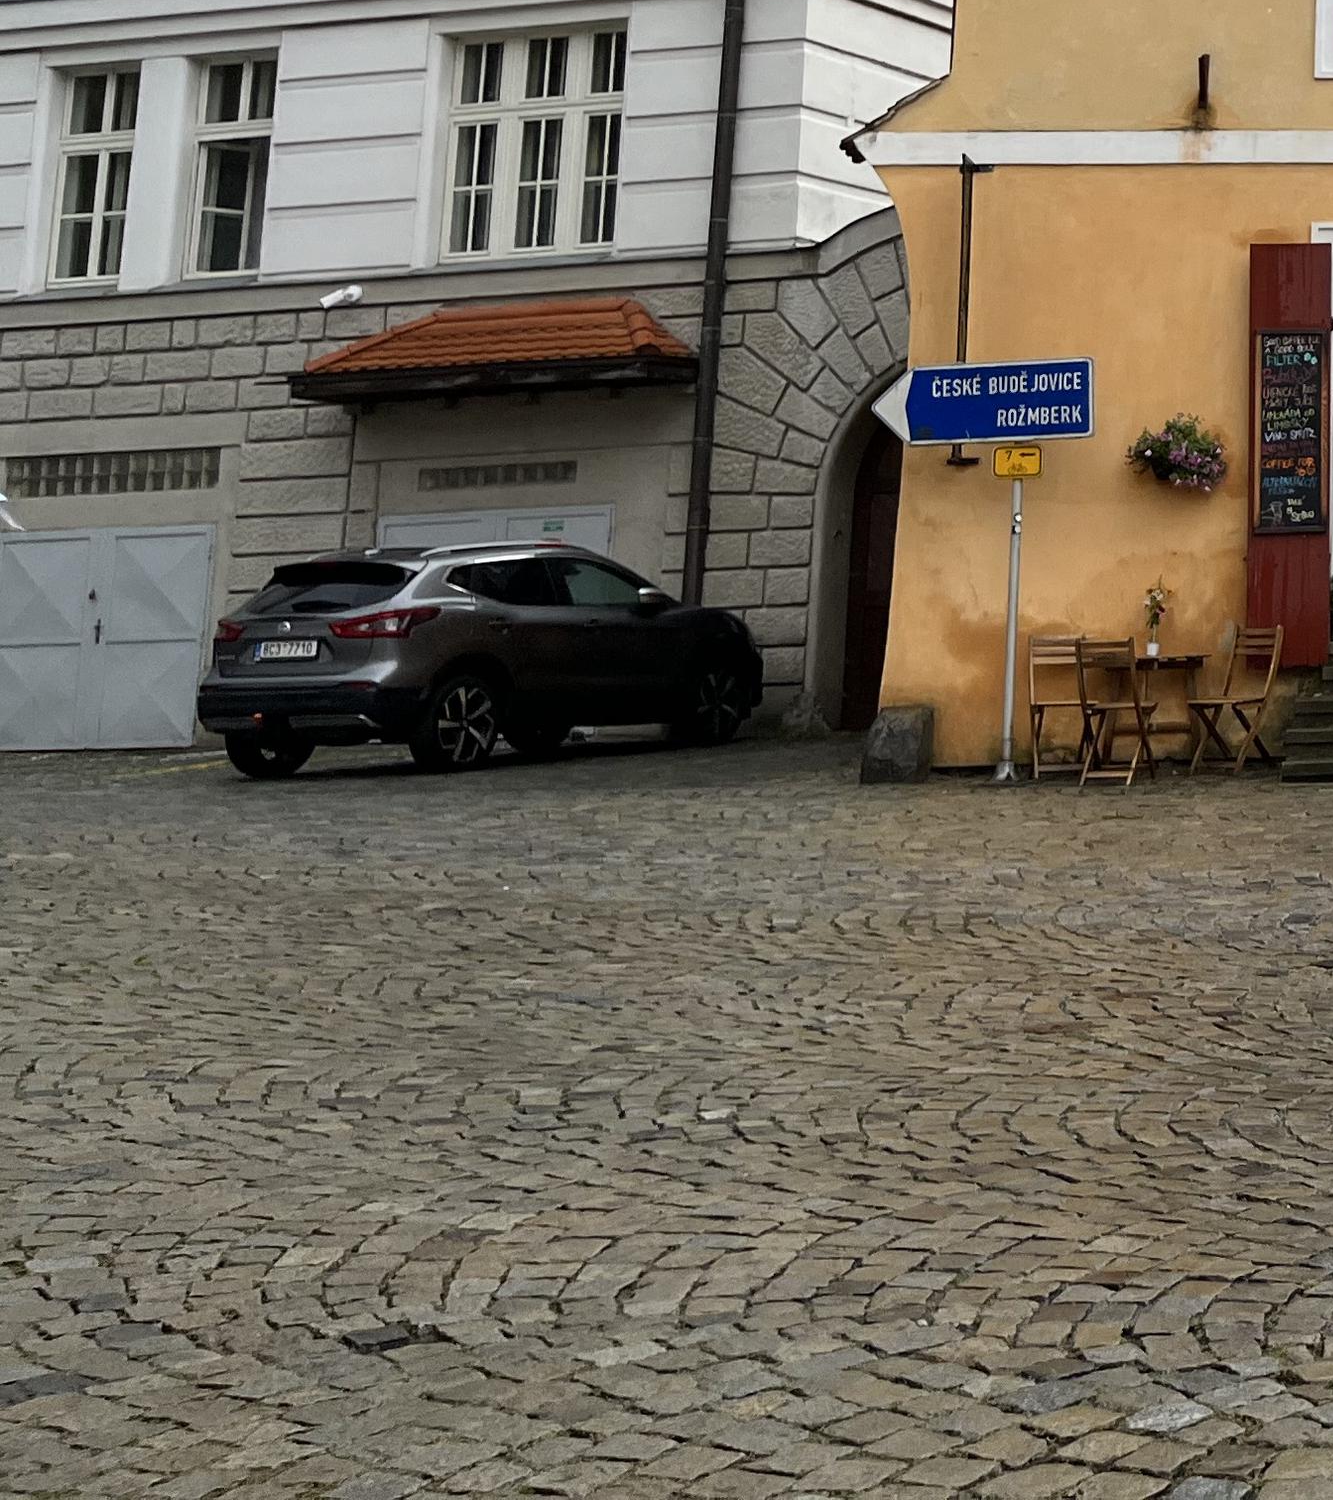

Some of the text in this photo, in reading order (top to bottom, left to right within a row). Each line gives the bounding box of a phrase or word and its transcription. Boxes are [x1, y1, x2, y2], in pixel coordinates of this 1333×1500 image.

[1266, 355, 1302, 367] FILTER
[932, 371, 1082, 398] ČESKÉ BUDĚJOVICE
[997, 404, 1082, 427] ROŽMBERK
[1005, 450, 1013, 461] 7
[288, 641, 313, 654] 7710
